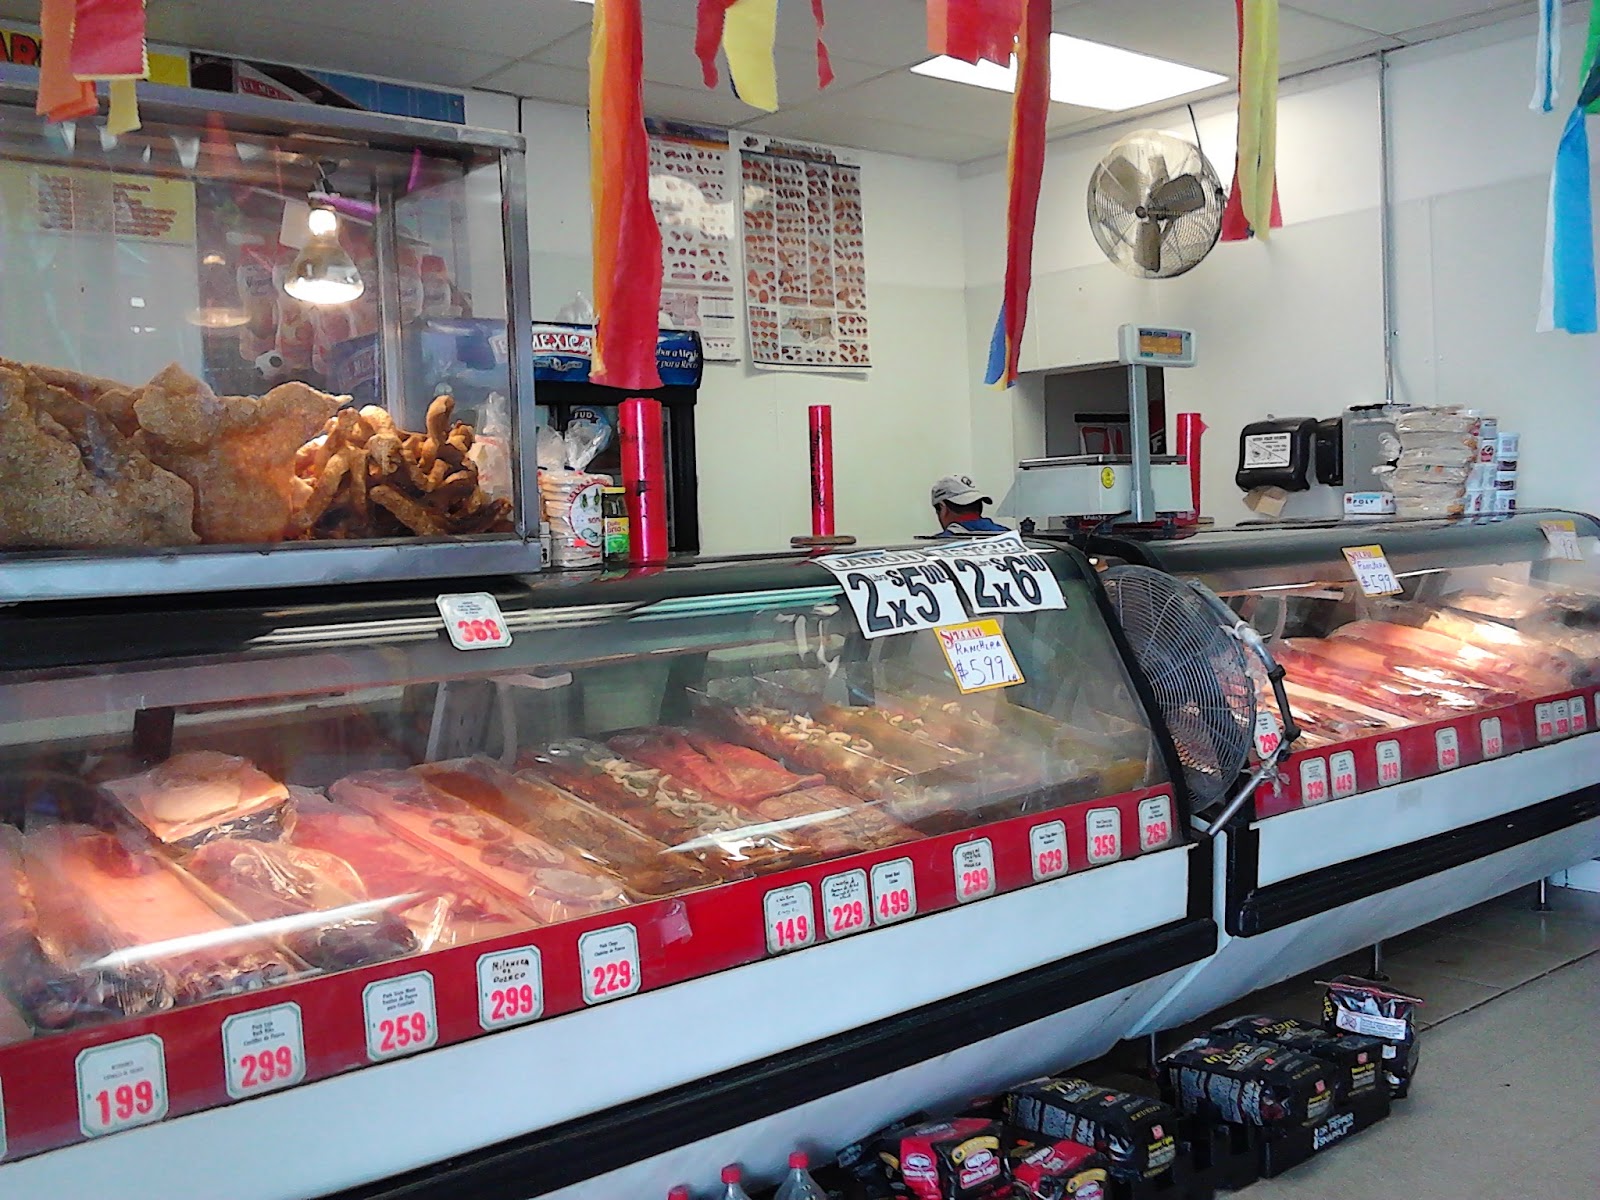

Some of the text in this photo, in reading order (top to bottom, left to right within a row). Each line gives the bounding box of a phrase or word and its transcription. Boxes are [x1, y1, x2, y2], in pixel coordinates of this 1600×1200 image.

[835, 551, 918, 568] JAMON
[1093, 834, 1116, 856] 359
[963, 868, 989, 896] 299
[833, 901, 863, 932] 229
[880, 888, 910, 918] 499
[775, 915, 808, 947] 149
[592, 959, 632, 996] 229
[490, 984, 533, 1020] 299
[379, 1011, 427, 1052] 259
[240, 1046, 293, 1088] 299
[96, 1080, 154, 1126] 199
